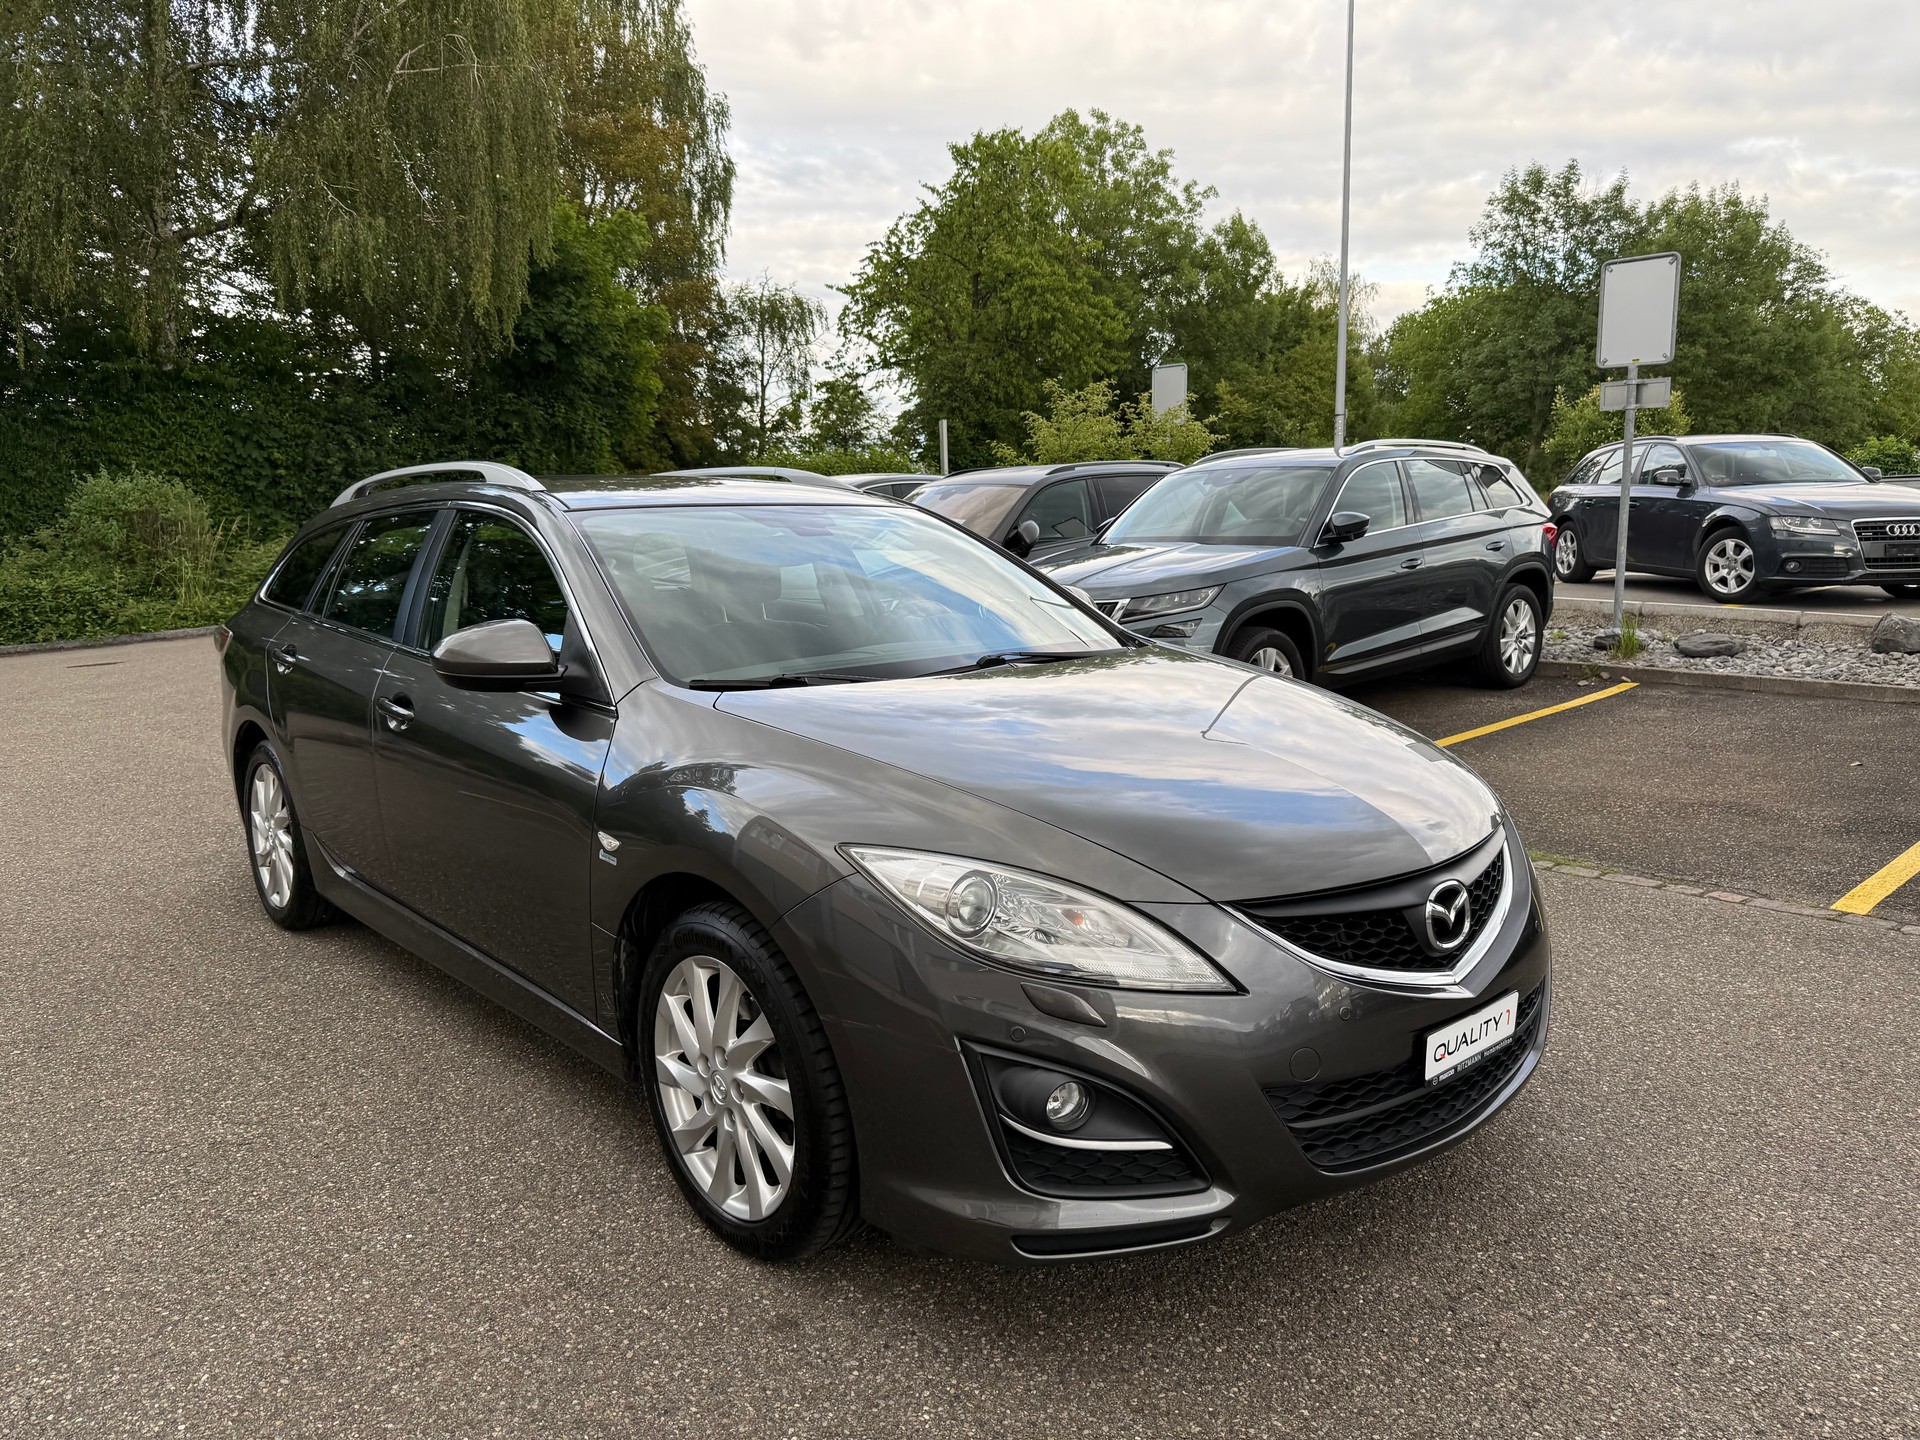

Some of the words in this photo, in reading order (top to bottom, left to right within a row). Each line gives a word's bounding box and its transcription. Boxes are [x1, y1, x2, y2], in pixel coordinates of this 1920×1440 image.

[1433, 1012, 1503, 1063] QUALITY
[1506, 1009, 1511, 1025] 1
[1457, 1053, 1482, 1073] RITZMANN
